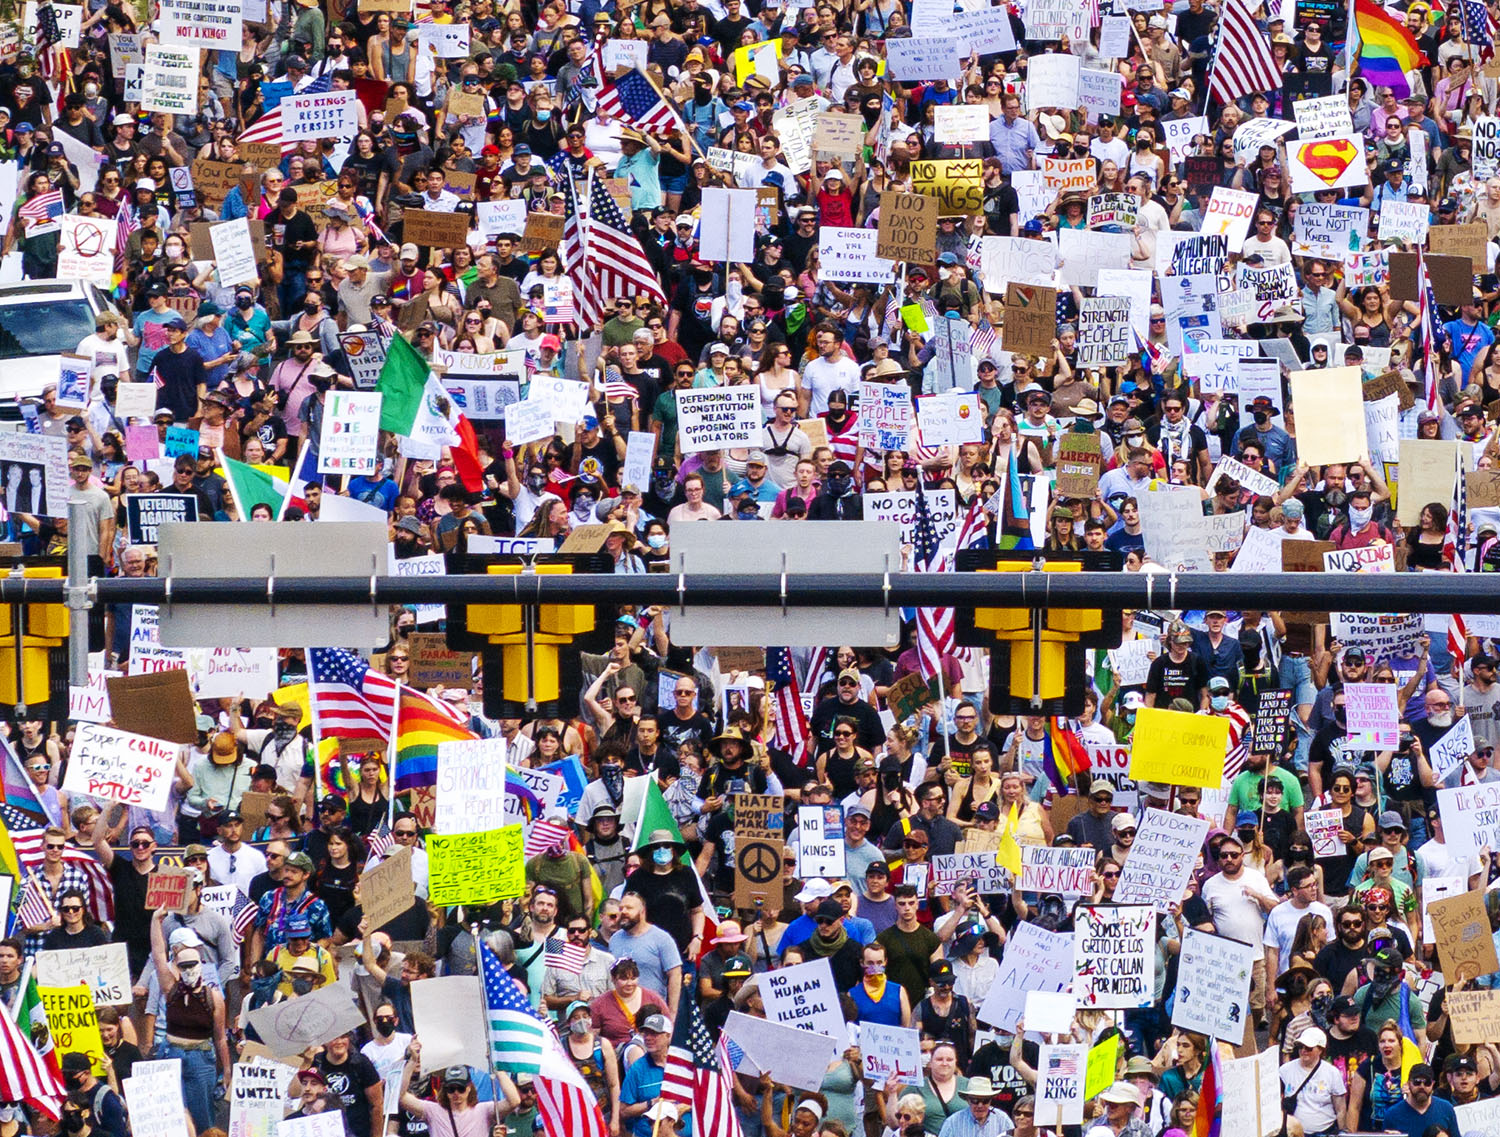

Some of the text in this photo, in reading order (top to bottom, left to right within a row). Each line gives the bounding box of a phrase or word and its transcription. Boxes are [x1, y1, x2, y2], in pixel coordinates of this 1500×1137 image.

[295, 96, 347, 108] NO KINGS
[299, 109, 344, 120] RESIST
[294, 120, 345, 133] PERSIST
[894, 195, 924, 212] 100
[1298, 204, 1363, 220] LADY LIBERTY
[889, 214, 925, 230] DAYS
[1301, 218, 1347, 231] WILL NOT
[892, 230, 918, 244] 100
[1304, 227, 1333, 243] KNEEL
[877, 244, 934, 263] DISASTERS
[680, 392, 755, 405] DEFENDING THE
[682, 402, 754, 414] CONSTITUTION
[702, 412, 736, 422] MEANS
[685, 421, 756, 435] OPPOSING ITS
[692, 432, 749, 444] VIOLATORS
[804, 820, 818, 830] NO
[803, 845, 836, 857] KINGS
[1089, 922, 1136, 938] SOMOS EL
[1082, 939, 1144, 954] GRITO DE LOS
[1096, 958, 1144, 976] SE CALLAN
[769, 976, 787, 987] NO
[1092, 977, 1142, 995] POR MIEDO
[774, 979, 821, 999] HUMAN
[794, 995, 806, 1006] IS
[778, 1003, 828, 1022] ILLEGAL
